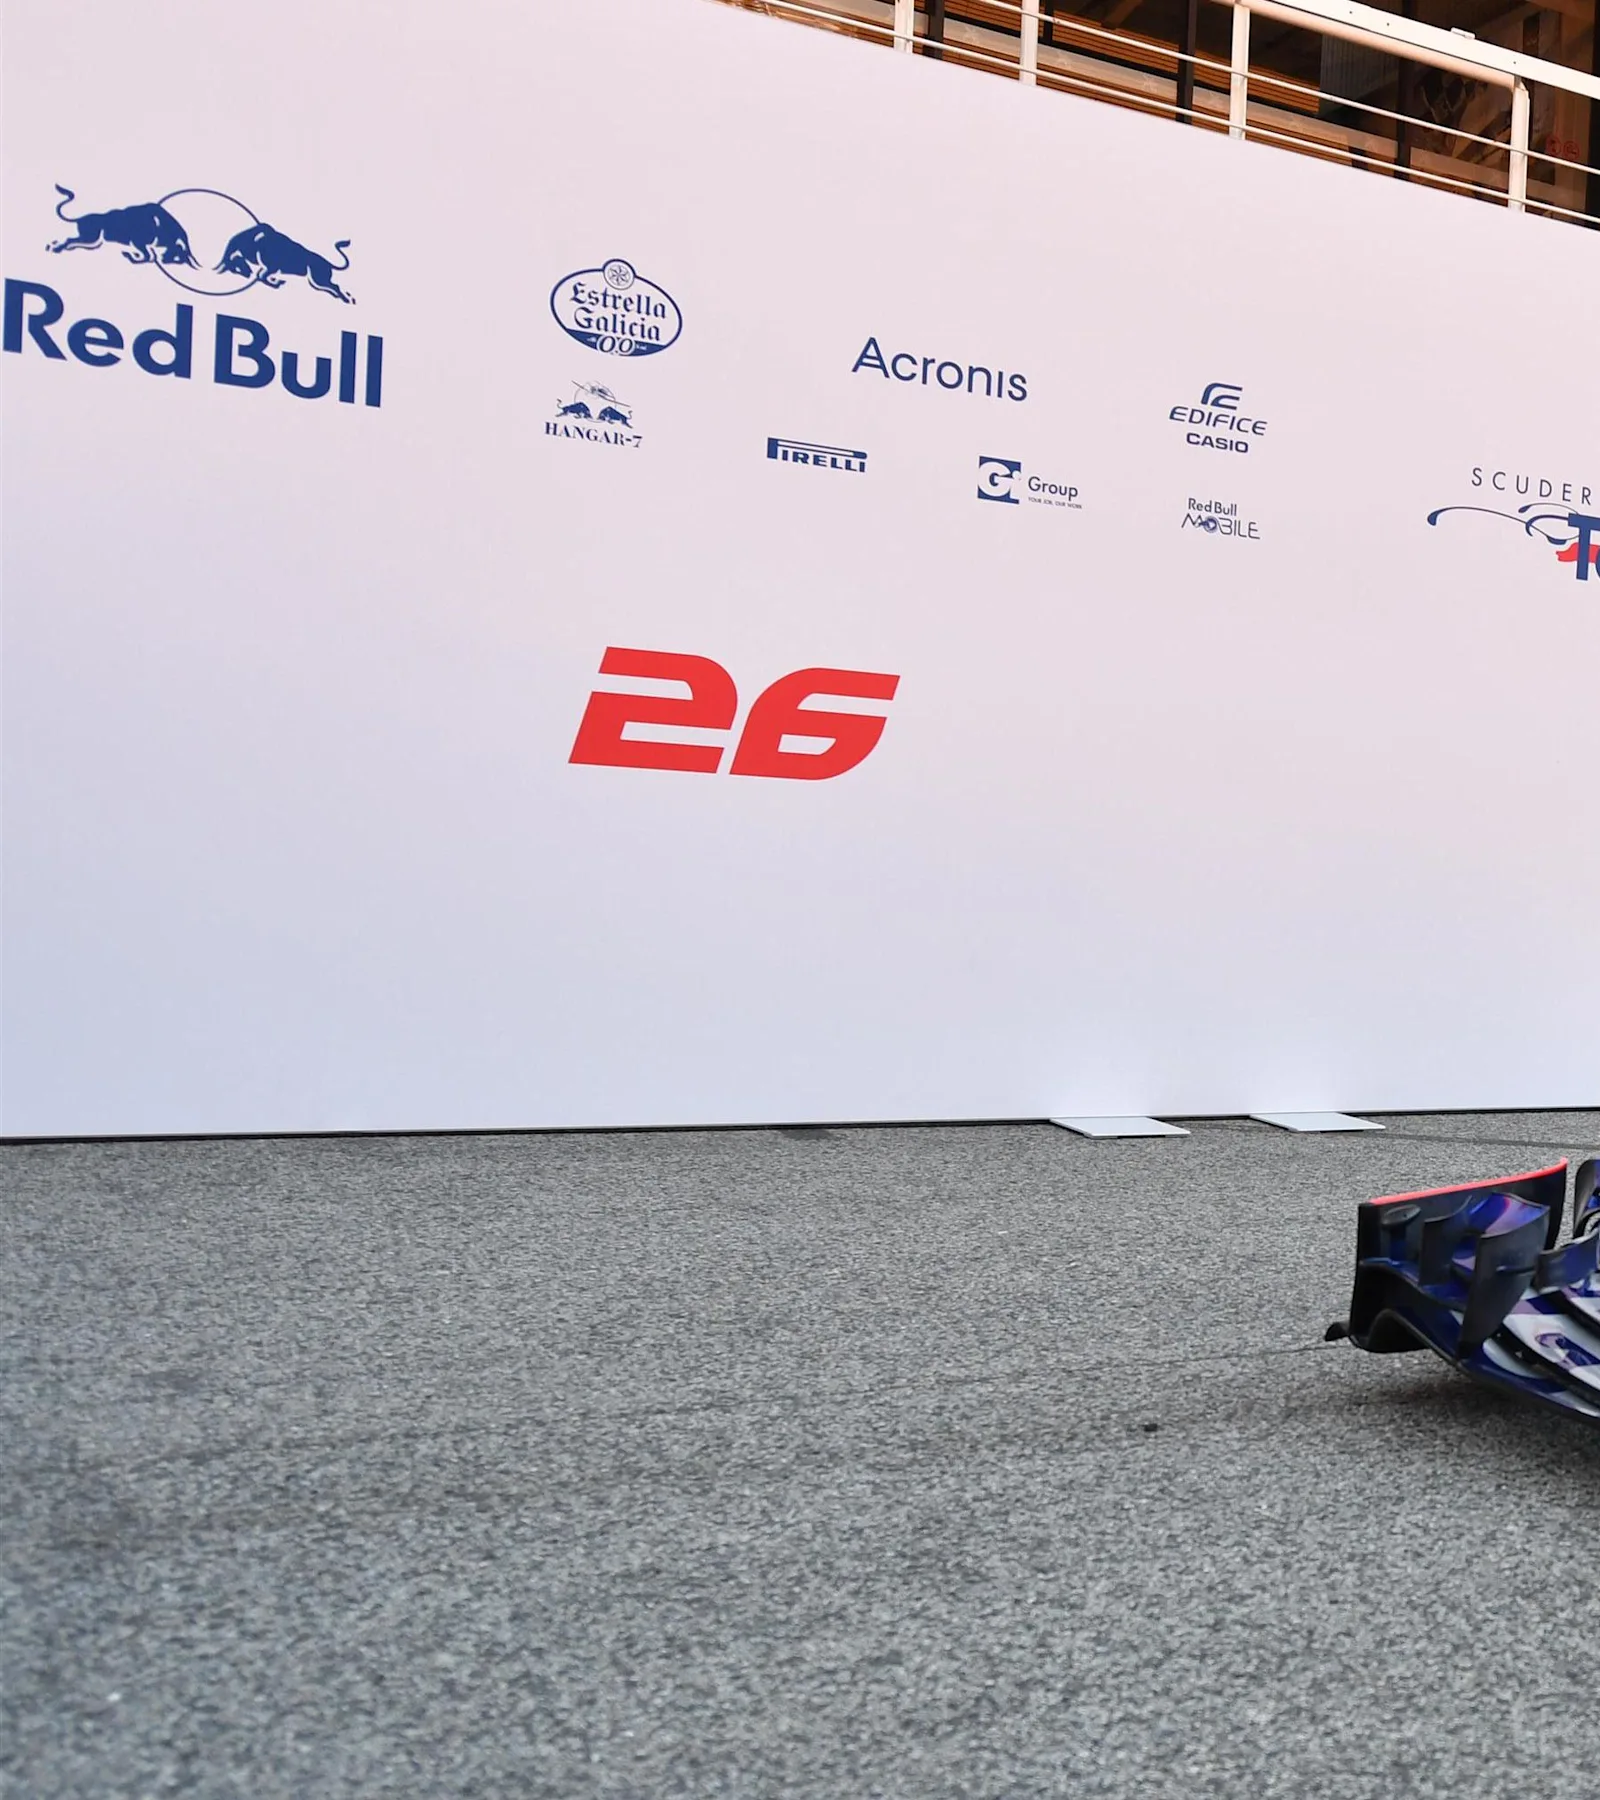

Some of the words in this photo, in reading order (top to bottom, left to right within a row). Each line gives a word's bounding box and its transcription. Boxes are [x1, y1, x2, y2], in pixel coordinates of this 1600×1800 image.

[570, 282, 667, 319] Estrella
[573, 306, 660, 342] Galicia
[3, 277, 194, 379] Red
[214, 313, 384, 408] Bull
[851, 337, 1028, 401] Acronis
[544, 421, 643, 448] HANGAR-7
[1169, 405, 1267, 436] EDIFICE
[767, 437, 867, 472] PIRELLI
[1186, 432, 1249, 453] CASIO
[1028, 475, 1079, 501] Group
[1188, 498, 1212, 513] Red
[1214, 501, 1237, 516] Bull
[1181, 512, 1261, 540] MOBILE
[568, 646, 900, 780] 26
